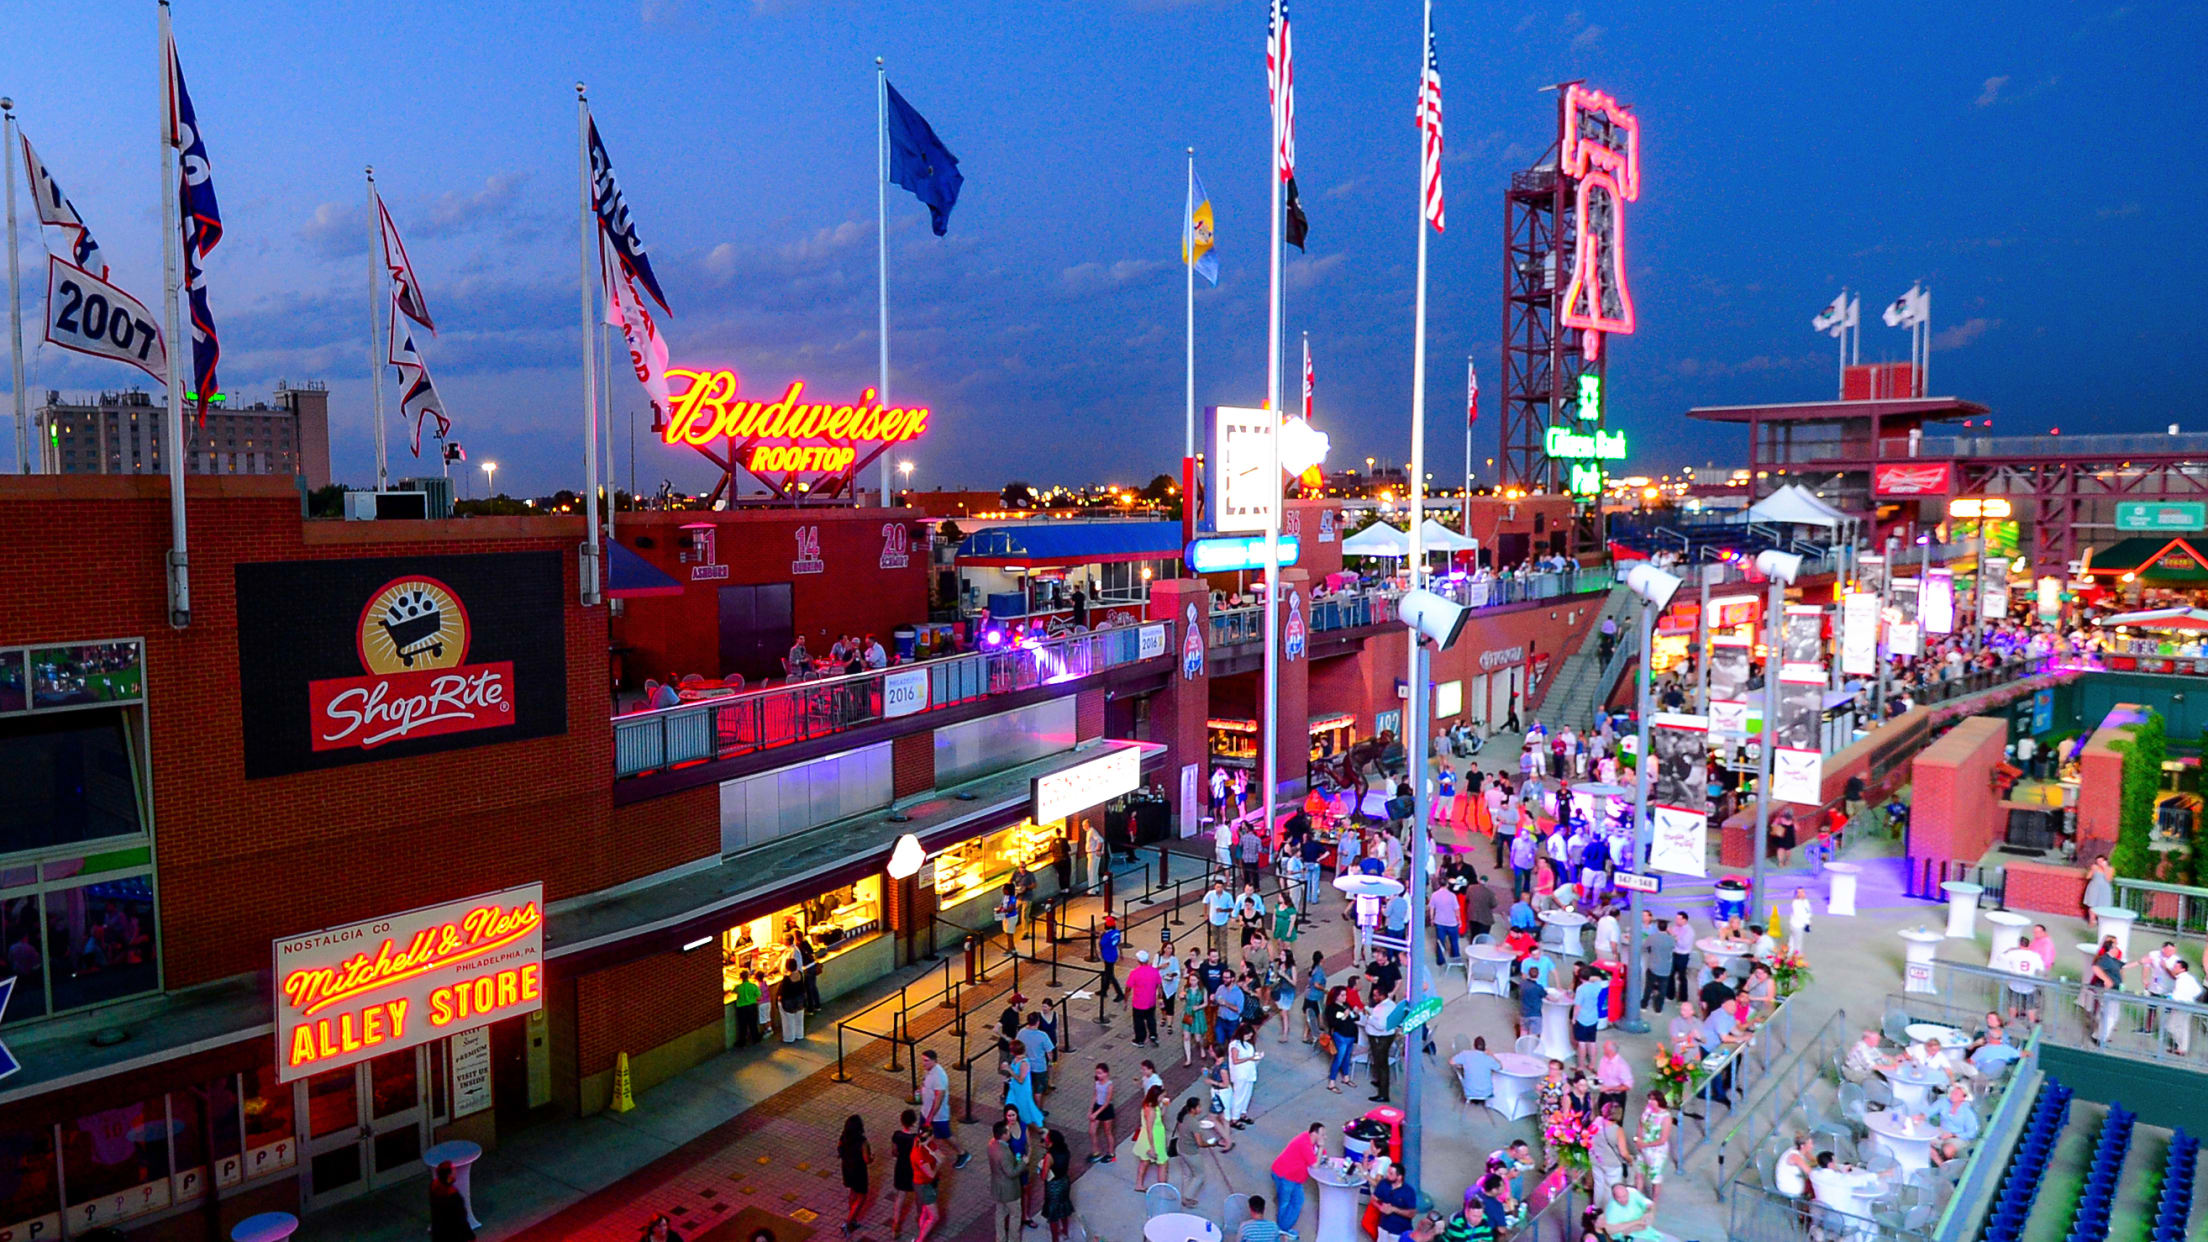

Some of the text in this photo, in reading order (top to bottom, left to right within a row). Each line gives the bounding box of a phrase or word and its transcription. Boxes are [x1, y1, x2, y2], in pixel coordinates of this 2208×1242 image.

[56, 279, 156, 361] 2007
[663, 368, 930, 445] Budweiser
[750, 446, 856, 472] ROOFTOP
[795, 526, 820, 561] 14
[882, 523, 906, 557] 20
[1142, 638, 1158, 650] 2016
[323, 669, 503, 741] ShopRite
[889, 686, 915, 704] 2016
[284, 922, 392, 955] NOSTALGIA CO.
[284, 901, 540, 1007] Mitchell & Ness
[456, 950, 524, 973] PHILADELPHIA,
[290, 964, 540, 1067] ALLEY STORE
[457, 1066, 489, 1082] VISIT US
[460, 1076, 485, 1089] INSIDE
[29, 1221, 44, 1240] P
